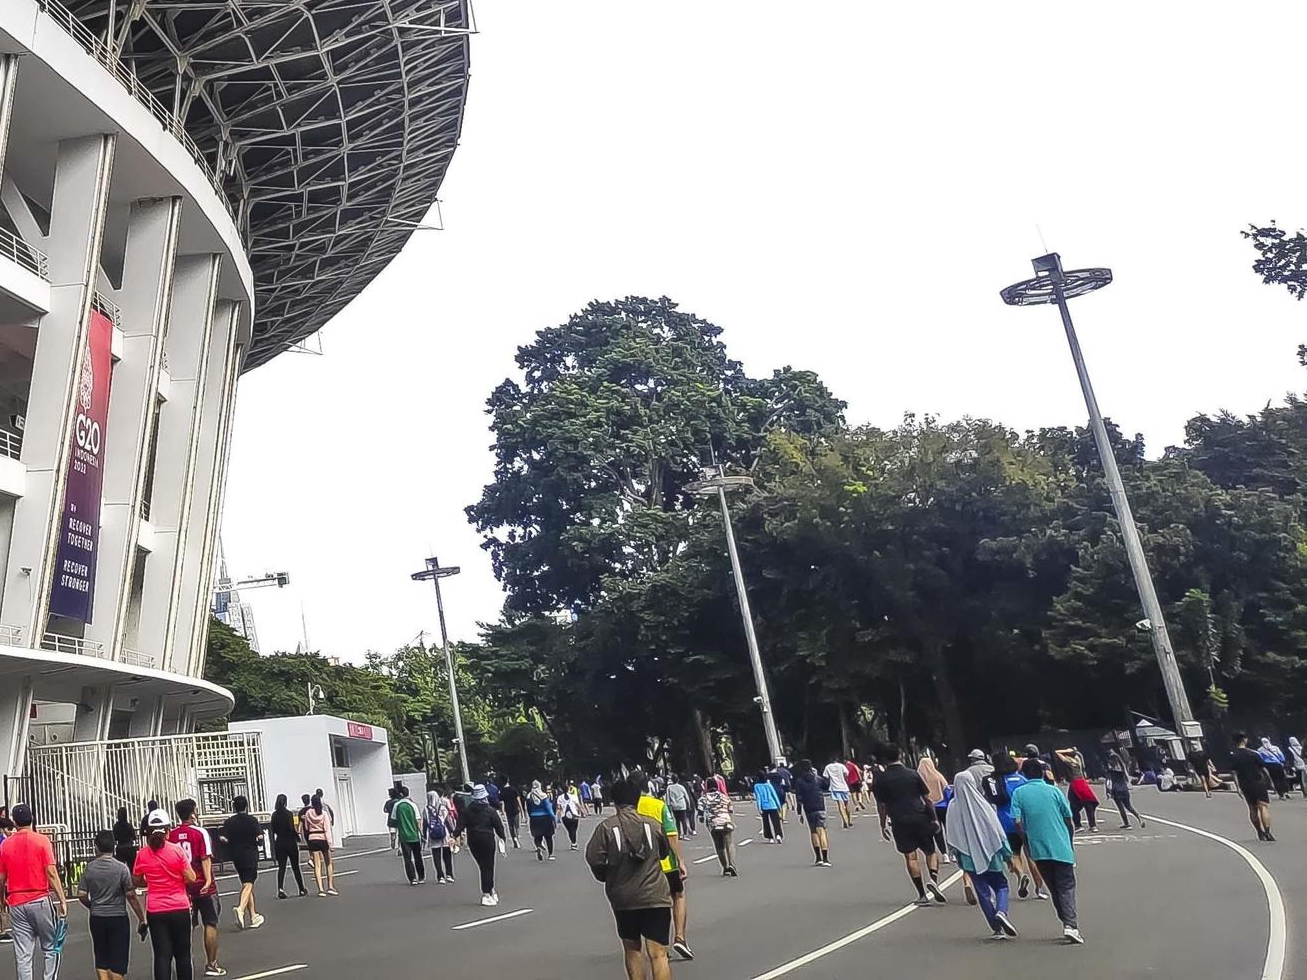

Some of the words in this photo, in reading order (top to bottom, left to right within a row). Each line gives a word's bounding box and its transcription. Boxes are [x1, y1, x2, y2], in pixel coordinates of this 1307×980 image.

[76, 413, 100, 455] G20
[69, 517, 92, 537] RECOVER
[67, 532, 93, 552] TOGETHER
[63, 559, 88, 577] RECOVER
[60, 574, 89, 592] STRONGER
